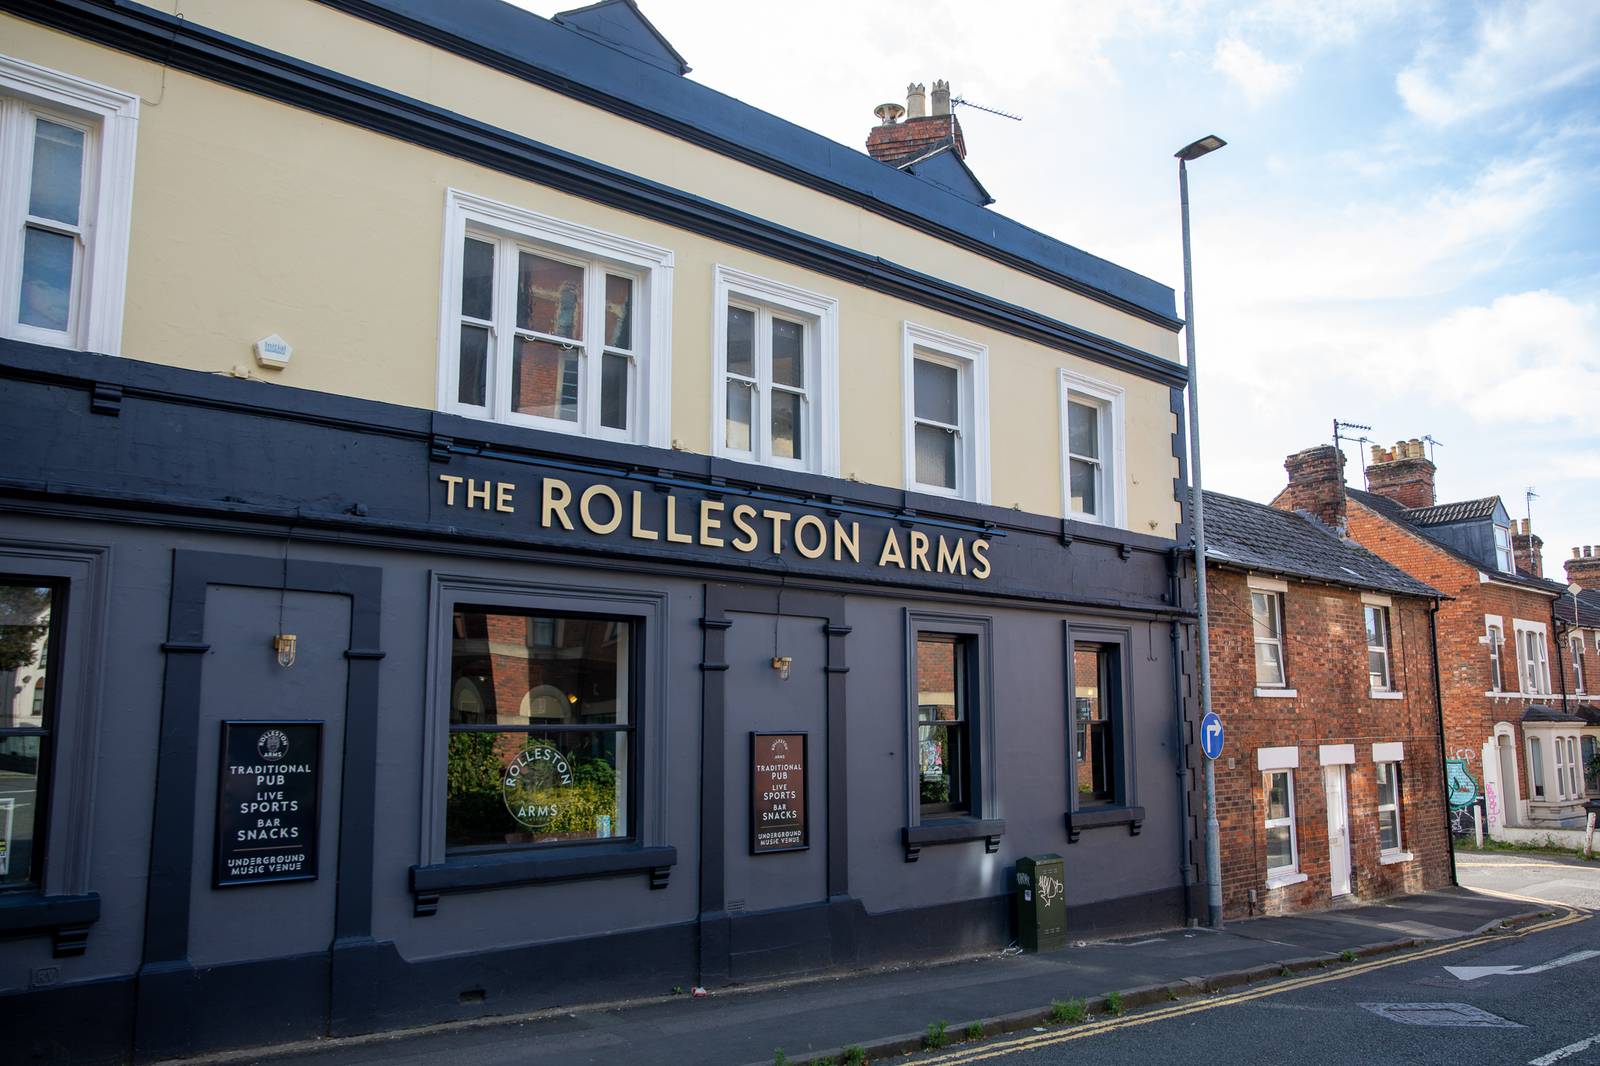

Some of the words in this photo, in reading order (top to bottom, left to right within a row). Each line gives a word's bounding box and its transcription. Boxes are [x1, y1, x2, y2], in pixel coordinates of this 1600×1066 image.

[439, 474, 515, 514] THE
[540, 477, 861, 563] ROLLESTON
[878, 527, 992, 580] ARMS
[230, 765, 311, 774] TRADITIONAL
[505, 748, 571, 787] ROLLESTON
[757, 764, 802, 772] TRADITIONAL
[257, 775, 285, 786] PUB
[771, 772, 788, 780] PUB
[257, 791, 284, 801] LIVE
[763, 791, 796, 801] SPORTS
[240, 801, 298, 814] SPORTS
[518, 804, 558, 817] ARMS
[762, 810, 797, 821] SNACKS
[257, 819, 281, 828] BAR
[237, 827, 299, 841] SNACKS
[758, 831, 802, 840] UNDERGROUND
[227, 854, 305, 867] UNDERGROUND
[231, 865, 265, 876] MUSIC
[268, 862, 302, 872] VENUE
